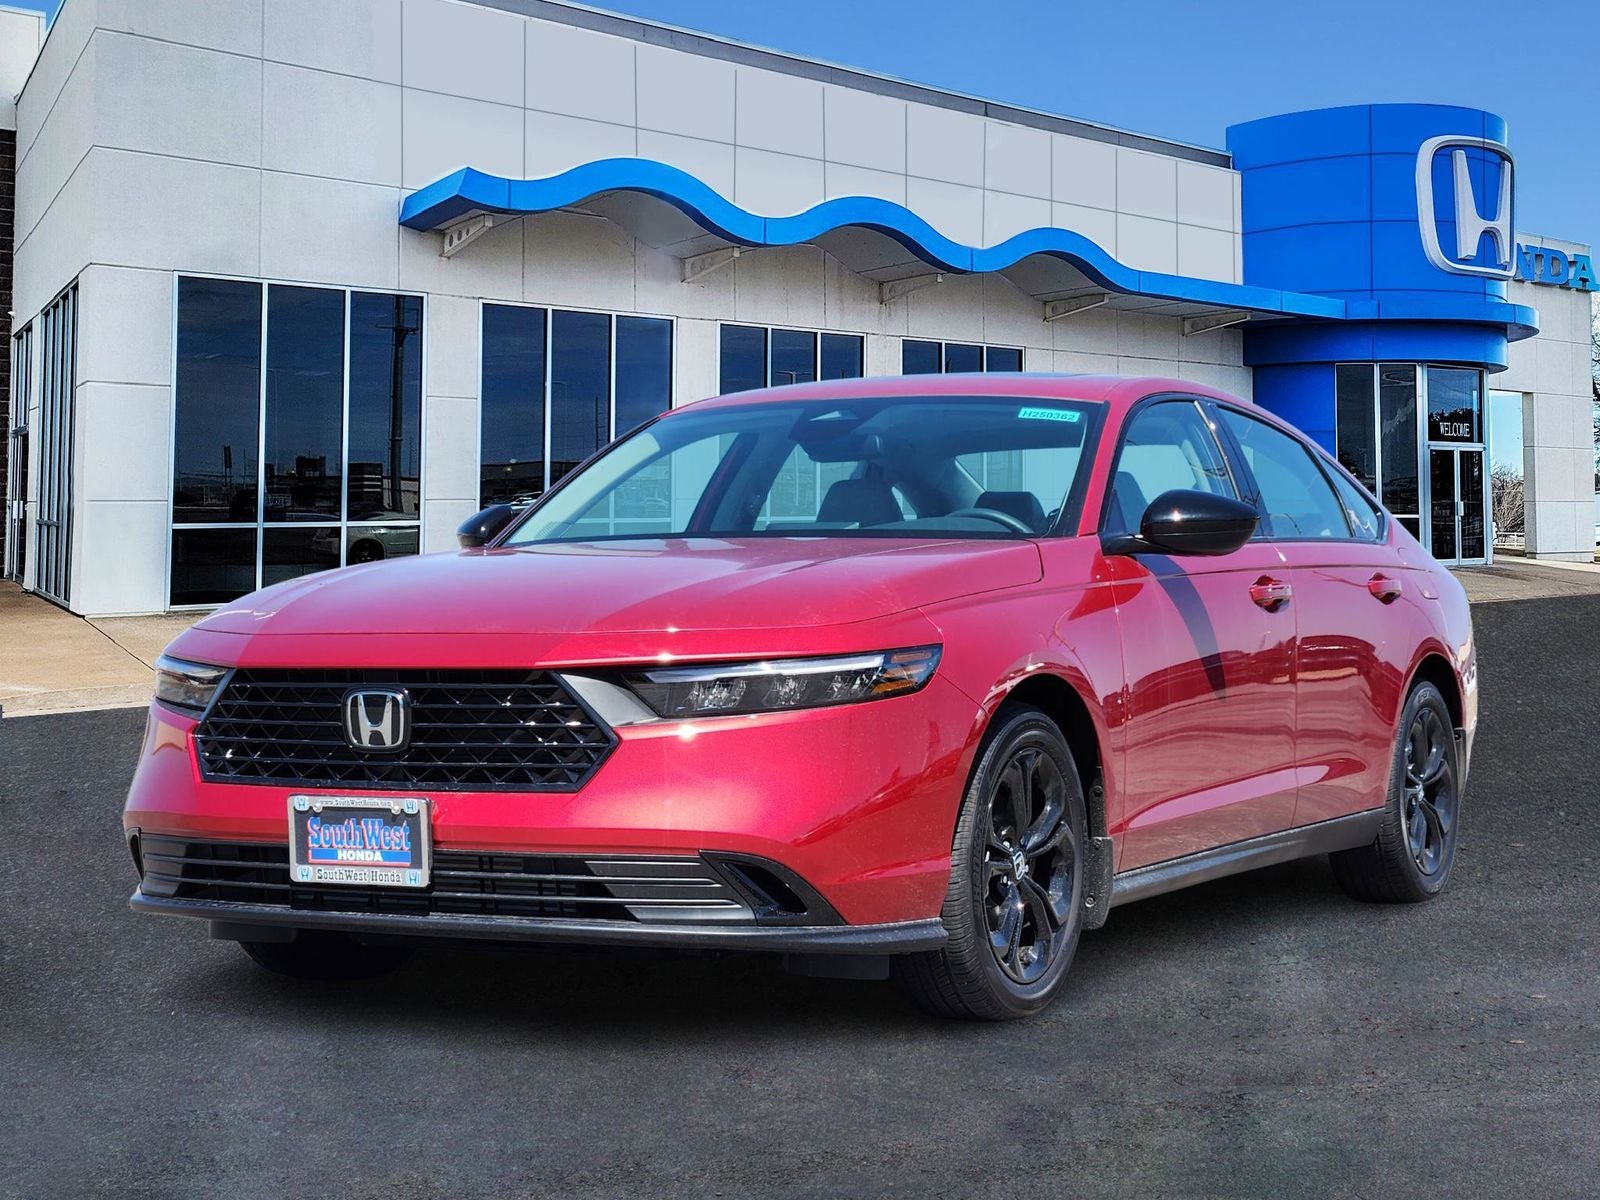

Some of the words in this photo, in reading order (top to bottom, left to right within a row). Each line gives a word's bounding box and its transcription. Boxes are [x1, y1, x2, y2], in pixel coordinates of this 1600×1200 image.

[1514, 243, 1600, 292] NDA
[1021, 410, 1076, 421] H250362
[1439, 422, 1471, 437] WELCOME
[307, 816, 412, 851] SouthWest
[337, 849, 384, 862] HONDA
[316, 868, 368, 882] SouthWest
[370, 870, 401, 883] Honda
